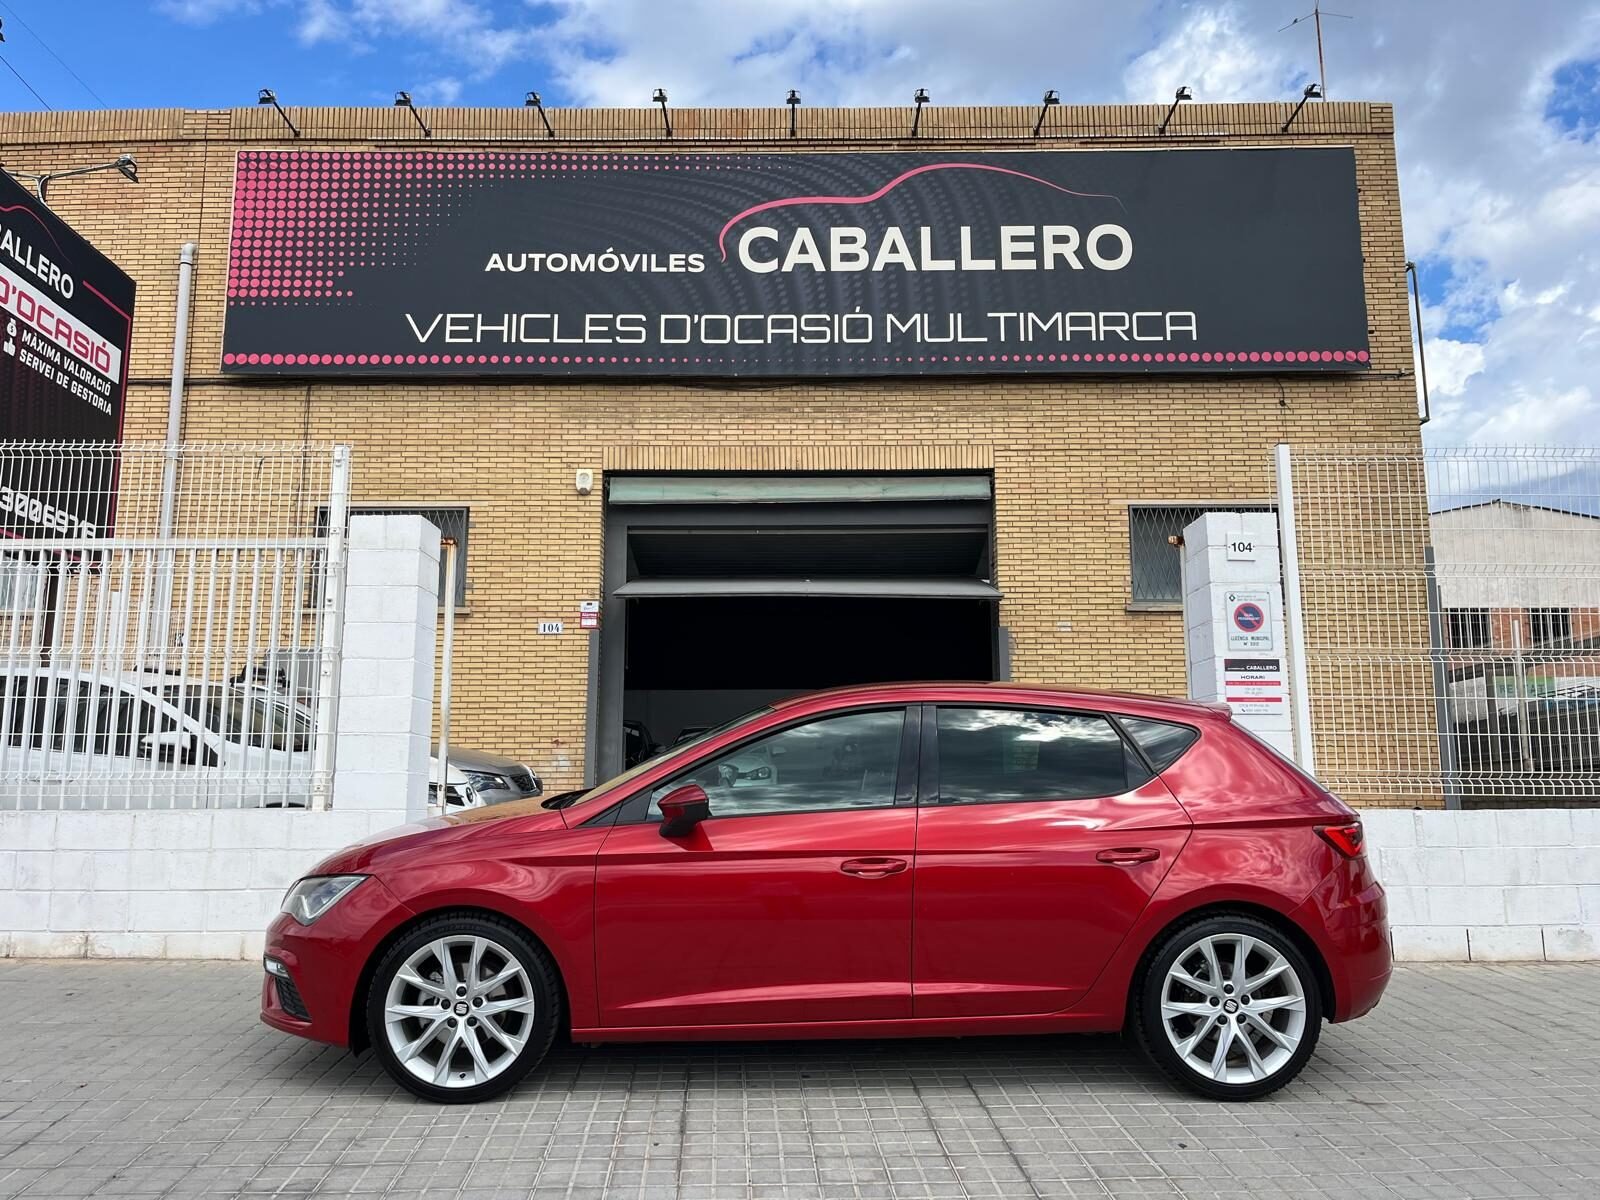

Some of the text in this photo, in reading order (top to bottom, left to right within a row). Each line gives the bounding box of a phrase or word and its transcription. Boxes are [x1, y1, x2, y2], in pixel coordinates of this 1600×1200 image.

[0, 224, 74, 299] ALLERO
[484, 224, 1134, 274] AUTOMÓVILES CABALLERO
[405, 306, 1198, 344] VEHICLES D'OCASIÓ MULTIMARCA
[20, 348, 112, 416] SERVEI DE GESTORIA
[22, 329, 111, 397] MÀXIMA VALORACIÓ
[1231, 542, 1253, 553] 104
[542, 623, 560, 633] 104
